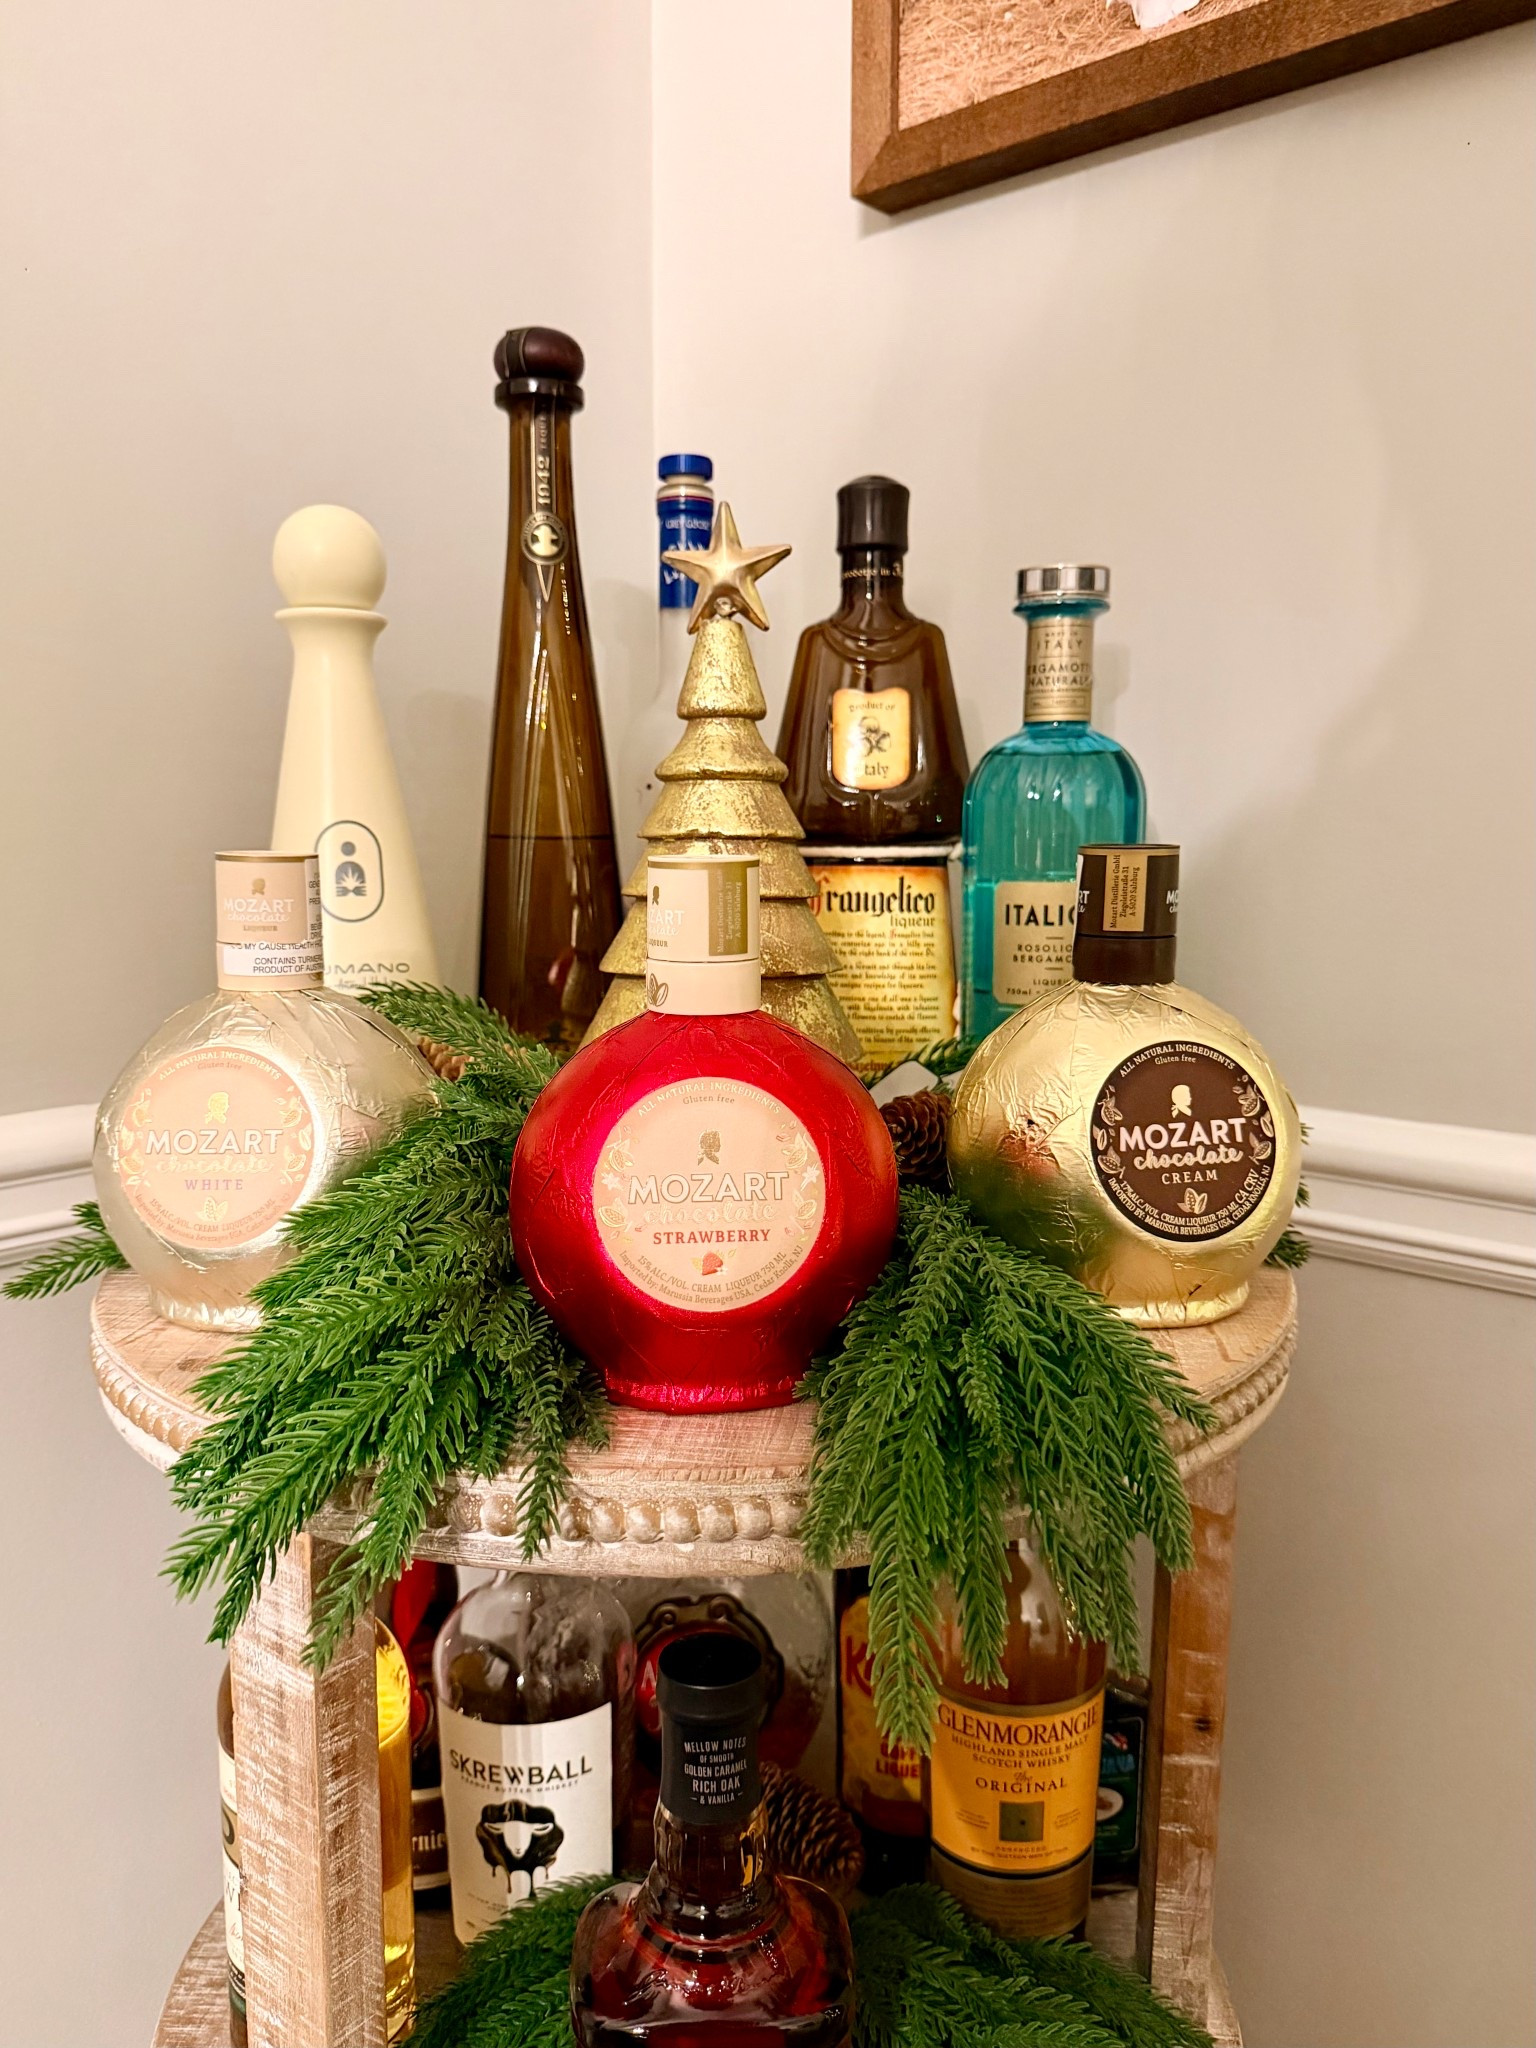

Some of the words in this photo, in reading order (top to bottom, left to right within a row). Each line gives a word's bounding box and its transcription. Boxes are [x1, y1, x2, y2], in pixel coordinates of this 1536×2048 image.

[536, 455, 551, 504] 1942
[1037, 640, 1082, 650] ITALY
[862, 762, 889, 779] taly
[1112, 854, 1121, 874] GmbH
[1121, 866, 1129, 874] 31
[1130, 866, 1140, 894] Salzburg
[1111, 875, 1119, 905] Distillerie
[224, 898, 294, 913] MOZART
[1129, 894, 1137, 917] A-5020
[890, 915, 936, 929] liqueur
[1109, 906, 1118, 929] Mozart
[258, 942, 286, 950] CAUSE
[1017, 944, 1072, 953] ROSOLIO
[253, 965, 293, 973] PRODUCT
[295, 964, 305, 972] OF
[255, 957, 296, 965] CONTAINS
[159, 1066, 175, 1081] ALL
[175, 1052, 219, 1070] NATURAL
[220, 1050, 282, 1081] INGREDIENTS
[1119, 1062, 1135, 1078] ALL
[1133, 1044, 1175, 1066] NATURAL
[1175, 1044, 1235, 1070] INGREDIENTS
[1154, 1055, 1180, 1065] Gluten
[1181, 1054, 1197, 1063] free
[637, 1101, 655, 1117] ALL
[657, 1082, 705, 1105] NATURAL
[710, 1081, 782, 1114] INGREDIENTS
[682, 1094, 714, 1105] Gluten
[716, 1094, 735, 1105] free
[145, 1128, 284, 1155] MOZART
[1119, 1117, 1247, 1152] MOZART
[156, 1155, 274, 1174] chocolate
[1133, 1144, 1244, 1170] chocolate
[184, 1179, 244, 1191] WHITE
[1161, 1169, 1218, 1185] CREAM
[627, 1171, 790, 1205] MOZART
[1161, 1213, 1187, 1226] CREAM
[1186, 1213, 1217, 1227] LIQUEUR
[1216, 1208, 1229, 1219] 750
[1226, 1201, 1239, 1213] ML
[1234, 1189, 1250, 1203] CA
[1243, 1168, 1259, 1191] CRV
[1108, 1177, 1136, 1211] IMPORTED
[1133, 1208, 1146, 1220] BY:
[1144, 1214, 1179, 1234] MARUSSIA
[1180, 1222, 1219, 1236] BEVERAGES
[1217, 1217, 1235, 1228] USA,
[1231, 1200, 1253, 1220] CEDAR
[1261, 1164, 1271, 1176] NJ
[644, 1202, 777, 1225] chocolate
[653, 1228, 771, 1245] STRAWBERRY
[619, 1250, 649, 1278] Imported
[647, 1275, 658, 1288] by:
[659, 1284, 692, 1302] Marussia
[694, 1294, 734, 1305] Beverages
[753, 1276, 775, 1292] Cedar
[773, 1257, 798, 1279] Knolls,
[792, 1244, 803, 1258] NJ
[691, 1284, 721, 1293] CREAM
[726, 1271, 762, 1291] LIQUEUR
[761, 1261, 776, 1275] 750
[773, 1251, 787, 1264] ML
[937, 1703, 1099, 1746] GLENMORANGIE
[684, 1741, 719, 1753] MELLOW
[723, 1737, 746, 1750] NOTES
[951, 1733, 1016, 1758] HIGHLAND
[1018, 1746, 1061, 1759] SINGLE
[1064, 1735, 1089, 1750] MALT
[700, 1755, 707, 1763] OF
[709, 1752, 734, 1763] SMOOTH
[972, 1752, 1023, 1769] SCOTCH
[1026, 1753, 1071, 1769] WHISKY
[449, 1749, 593, 1786] SKREWBALL
[684, 1763, 712, 1777] GOLDEN
[715, 1759, 747, 1777] CARAMEL
[692, 1779, 716, 1793] RICH
[721, 1776, 740, 1791] OAK
[975, 1777, 1067, 1794] ORIGINAL
[700, 1795, 705, 1804] &
[708, 1792, 734, 1804] VANILLA
